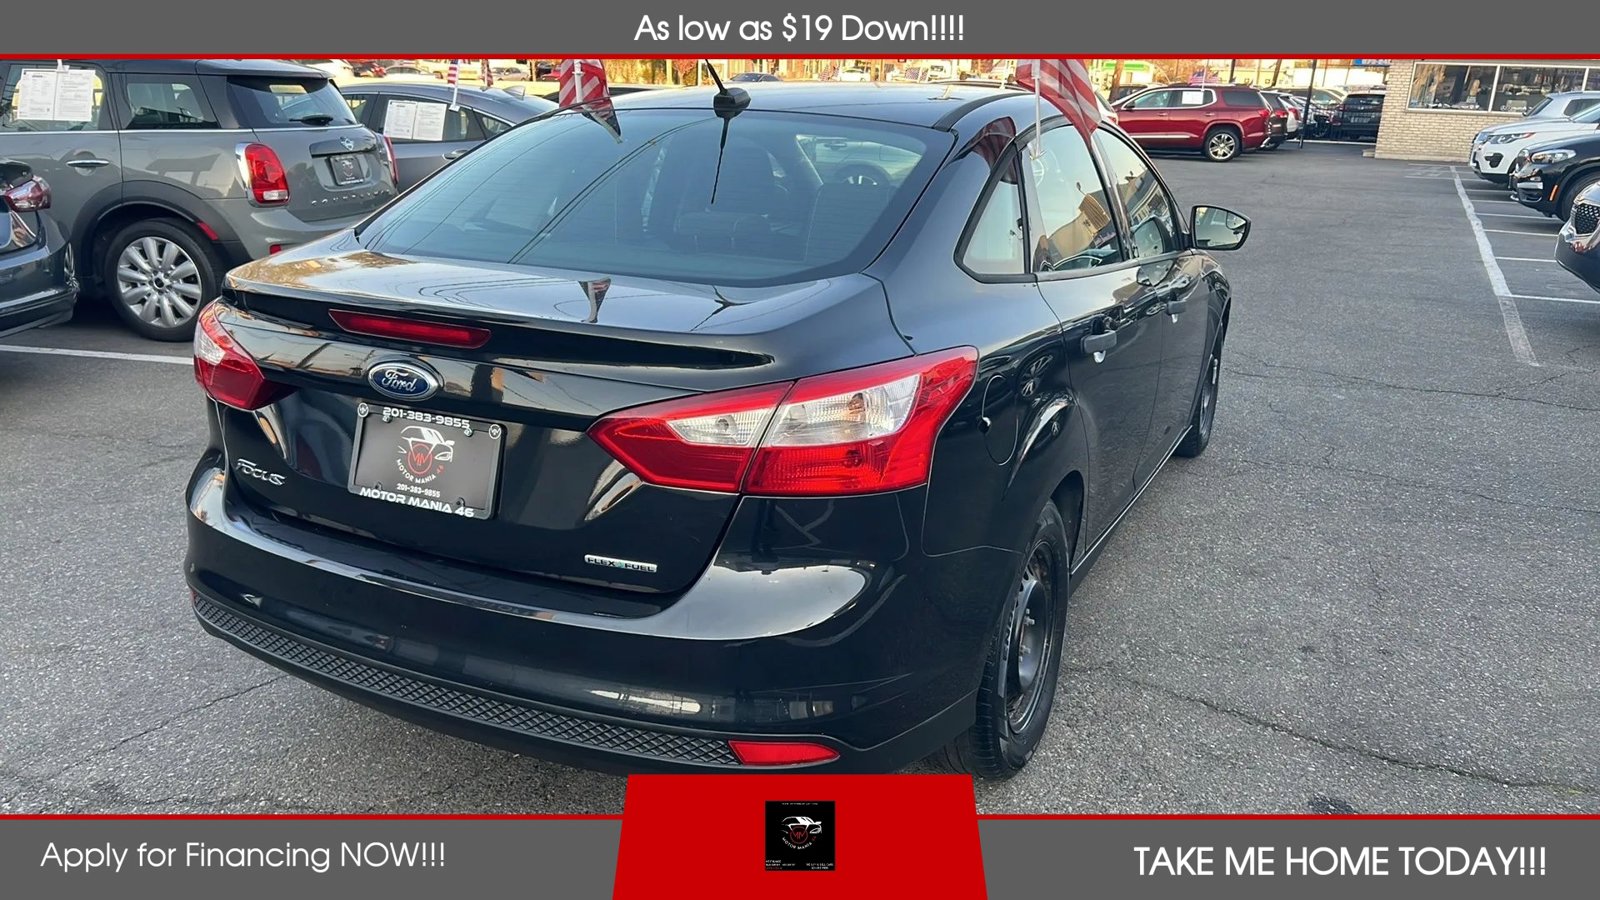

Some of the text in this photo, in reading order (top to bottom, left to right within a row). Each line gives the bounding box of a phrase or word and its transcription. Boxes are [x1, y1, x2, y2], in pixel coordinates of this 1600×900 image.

[382, 369, 417, 391] Ford
[383, 407, 470, 429] 201-383-9855
[397, 459, 414, 482] MOTOR
[415, 473, 436, 484] MANIA
[396, 483, 441, 498] 201-383-9855
[360, 487, 474, 518] MOTOR MANIA 46
[587, 557, 656, 572] FLEX FUEL
